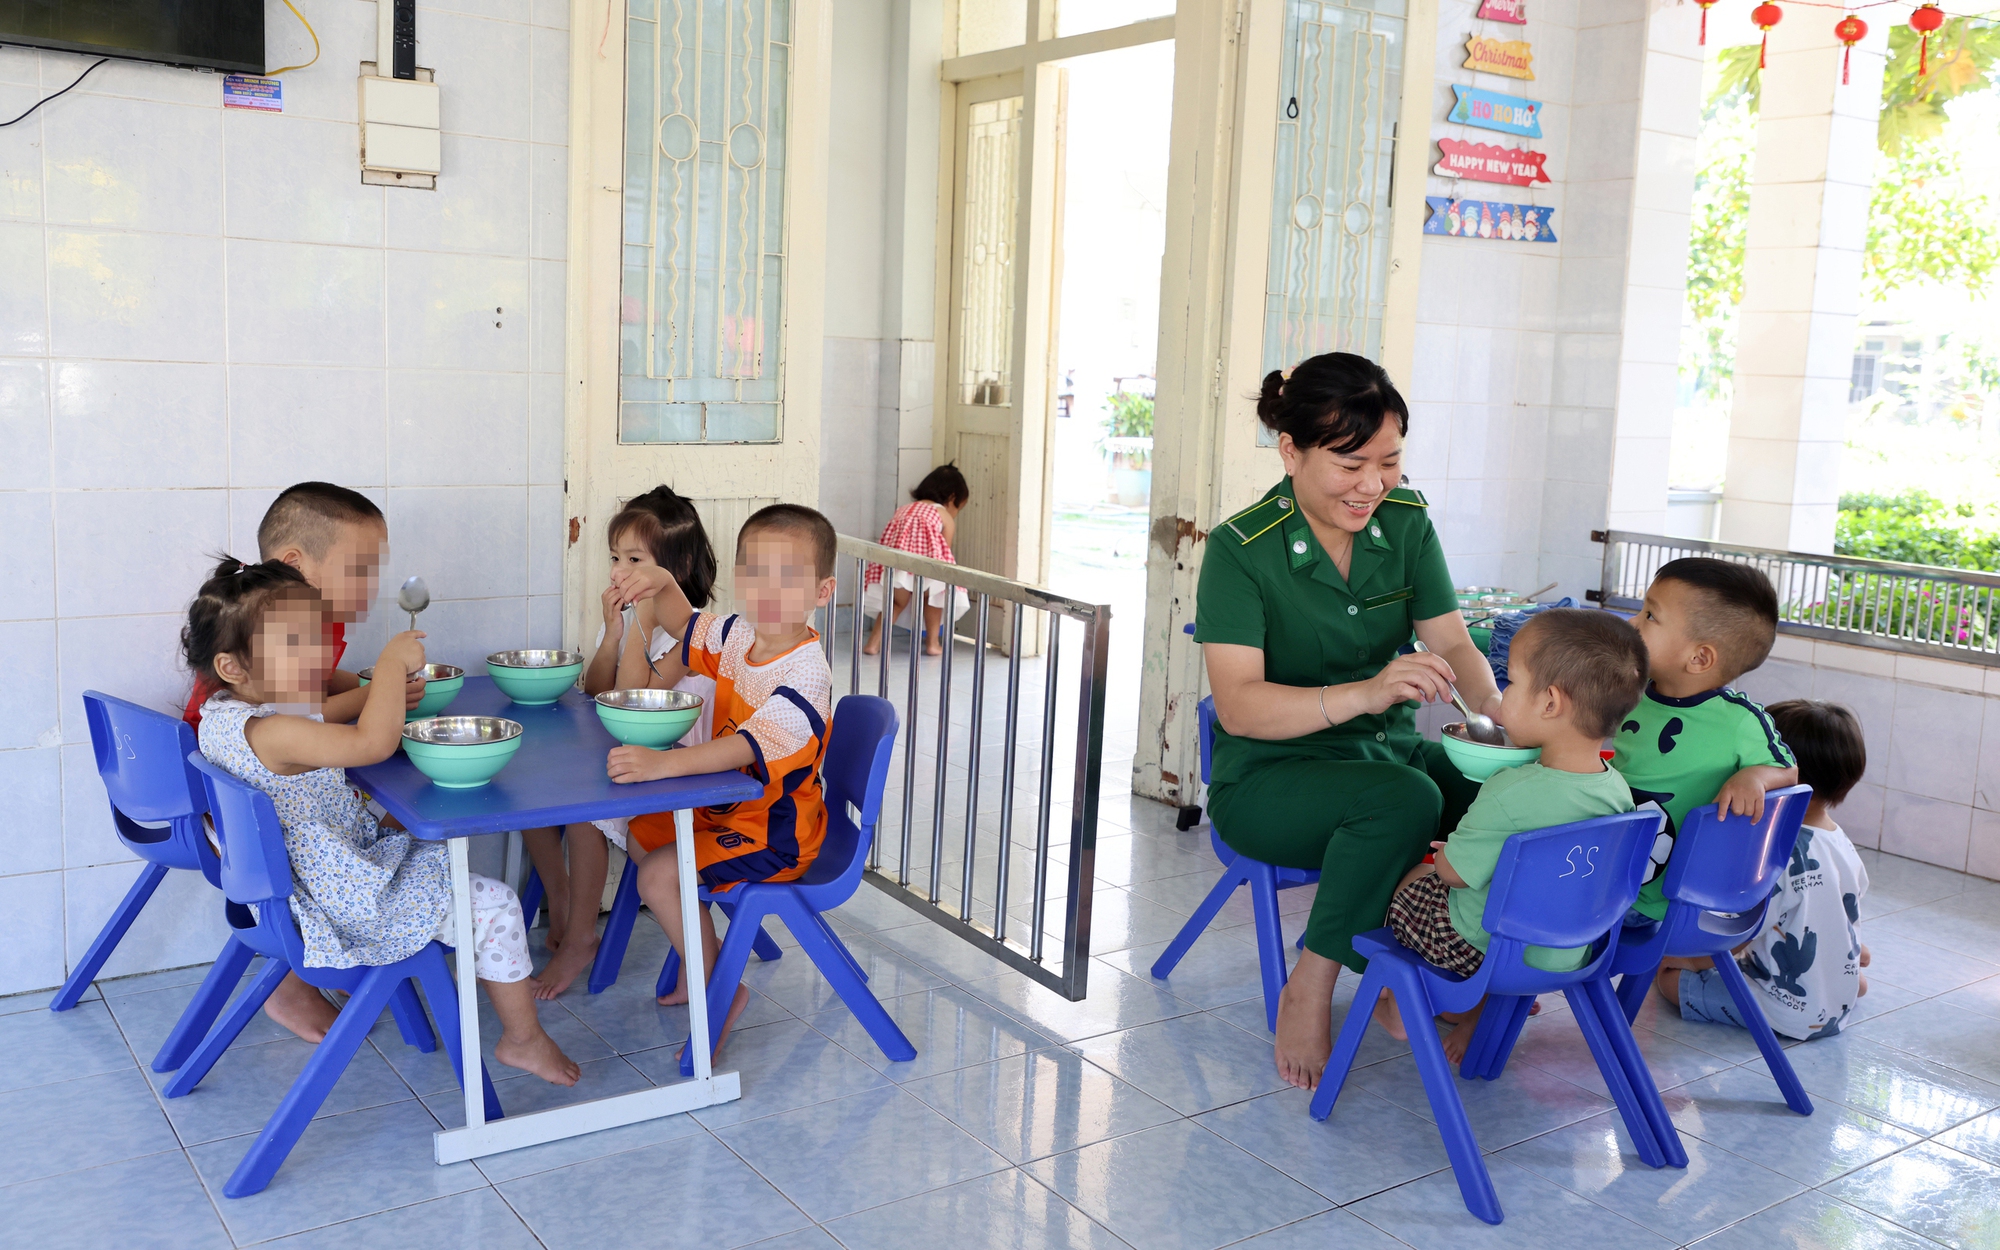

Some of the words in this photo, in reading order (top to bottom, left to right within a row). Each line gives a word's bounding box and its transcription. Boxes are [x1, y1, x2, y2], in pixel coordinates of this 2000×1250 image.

[1473, 41, 1528, 70] Christmas
[1471, 100, 1492, 119] HO
[1493, 104, 1513, 123] HO
[1513, 107, 1533, 128] HO
[1449, 154, 1485, 171] HAPPY
[1486, 159, 1510, 174] NEW
[1511, 162, 1539, 178] YEAR
